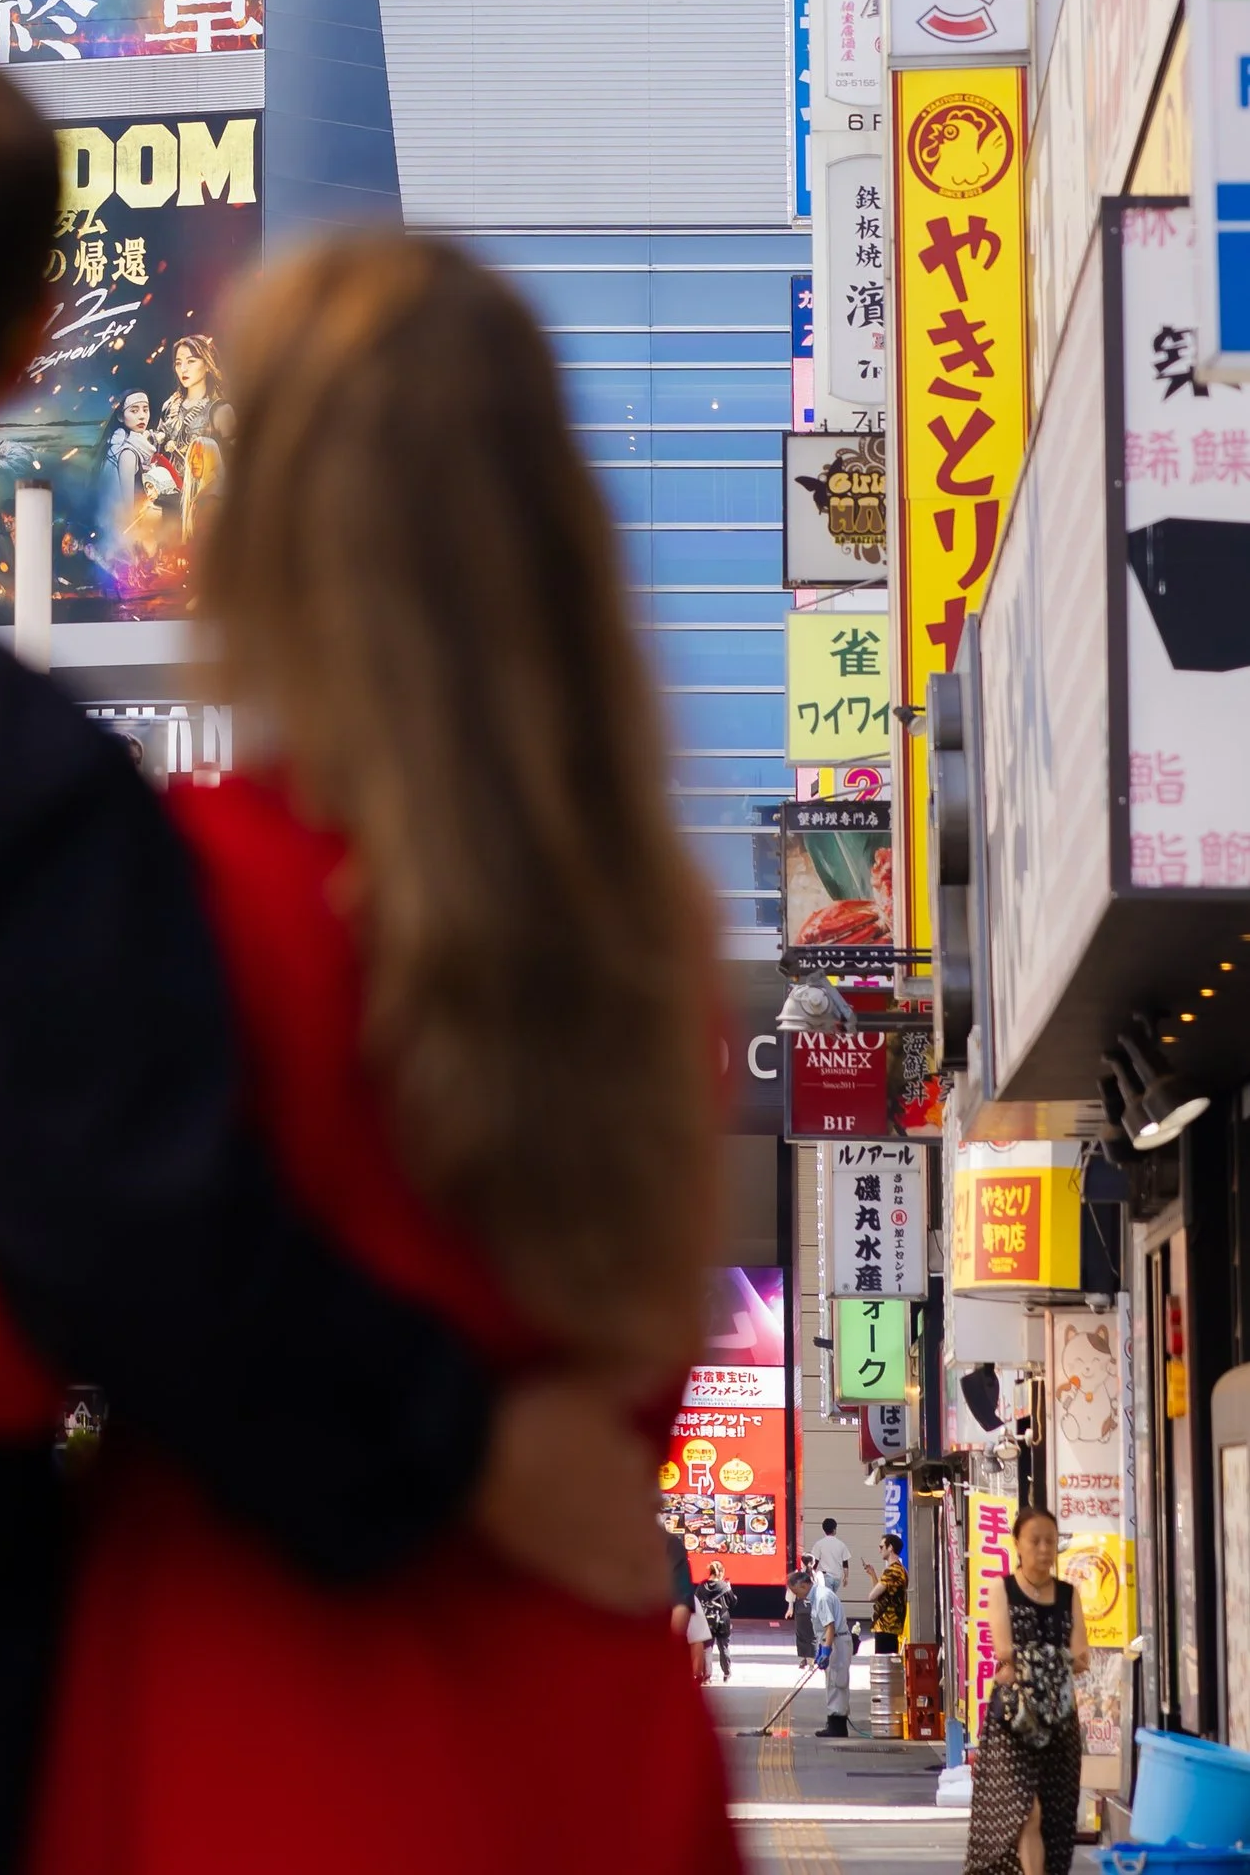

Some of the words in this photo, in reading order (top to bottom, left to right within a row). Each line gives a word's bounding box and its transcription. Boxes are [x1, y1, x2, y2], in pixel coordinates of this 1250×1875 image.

[855, 185, 883, 269] 鉄板焼
[830, 627, 881, 678] 雀
[806, 1051, 872, 1069] ANNEX
[823, 1115, 857, 1131] B1F
[838, 1144, 915, 1166] ルノアール
[980, 1183, 1032, 1218] やきとり
[854, 1173, 883, 1292] 磯丸水産
[981, 1221, 1027, 1254] 専門店
[691, 1370, 759, 1384] 新宿東宝ビル
[691, 1385, 763, 1397] インフォメーション
[1068, 1474, 1115, 1489] カラオケ
[1060, 1493, 1121, 1518] まねきねこ
